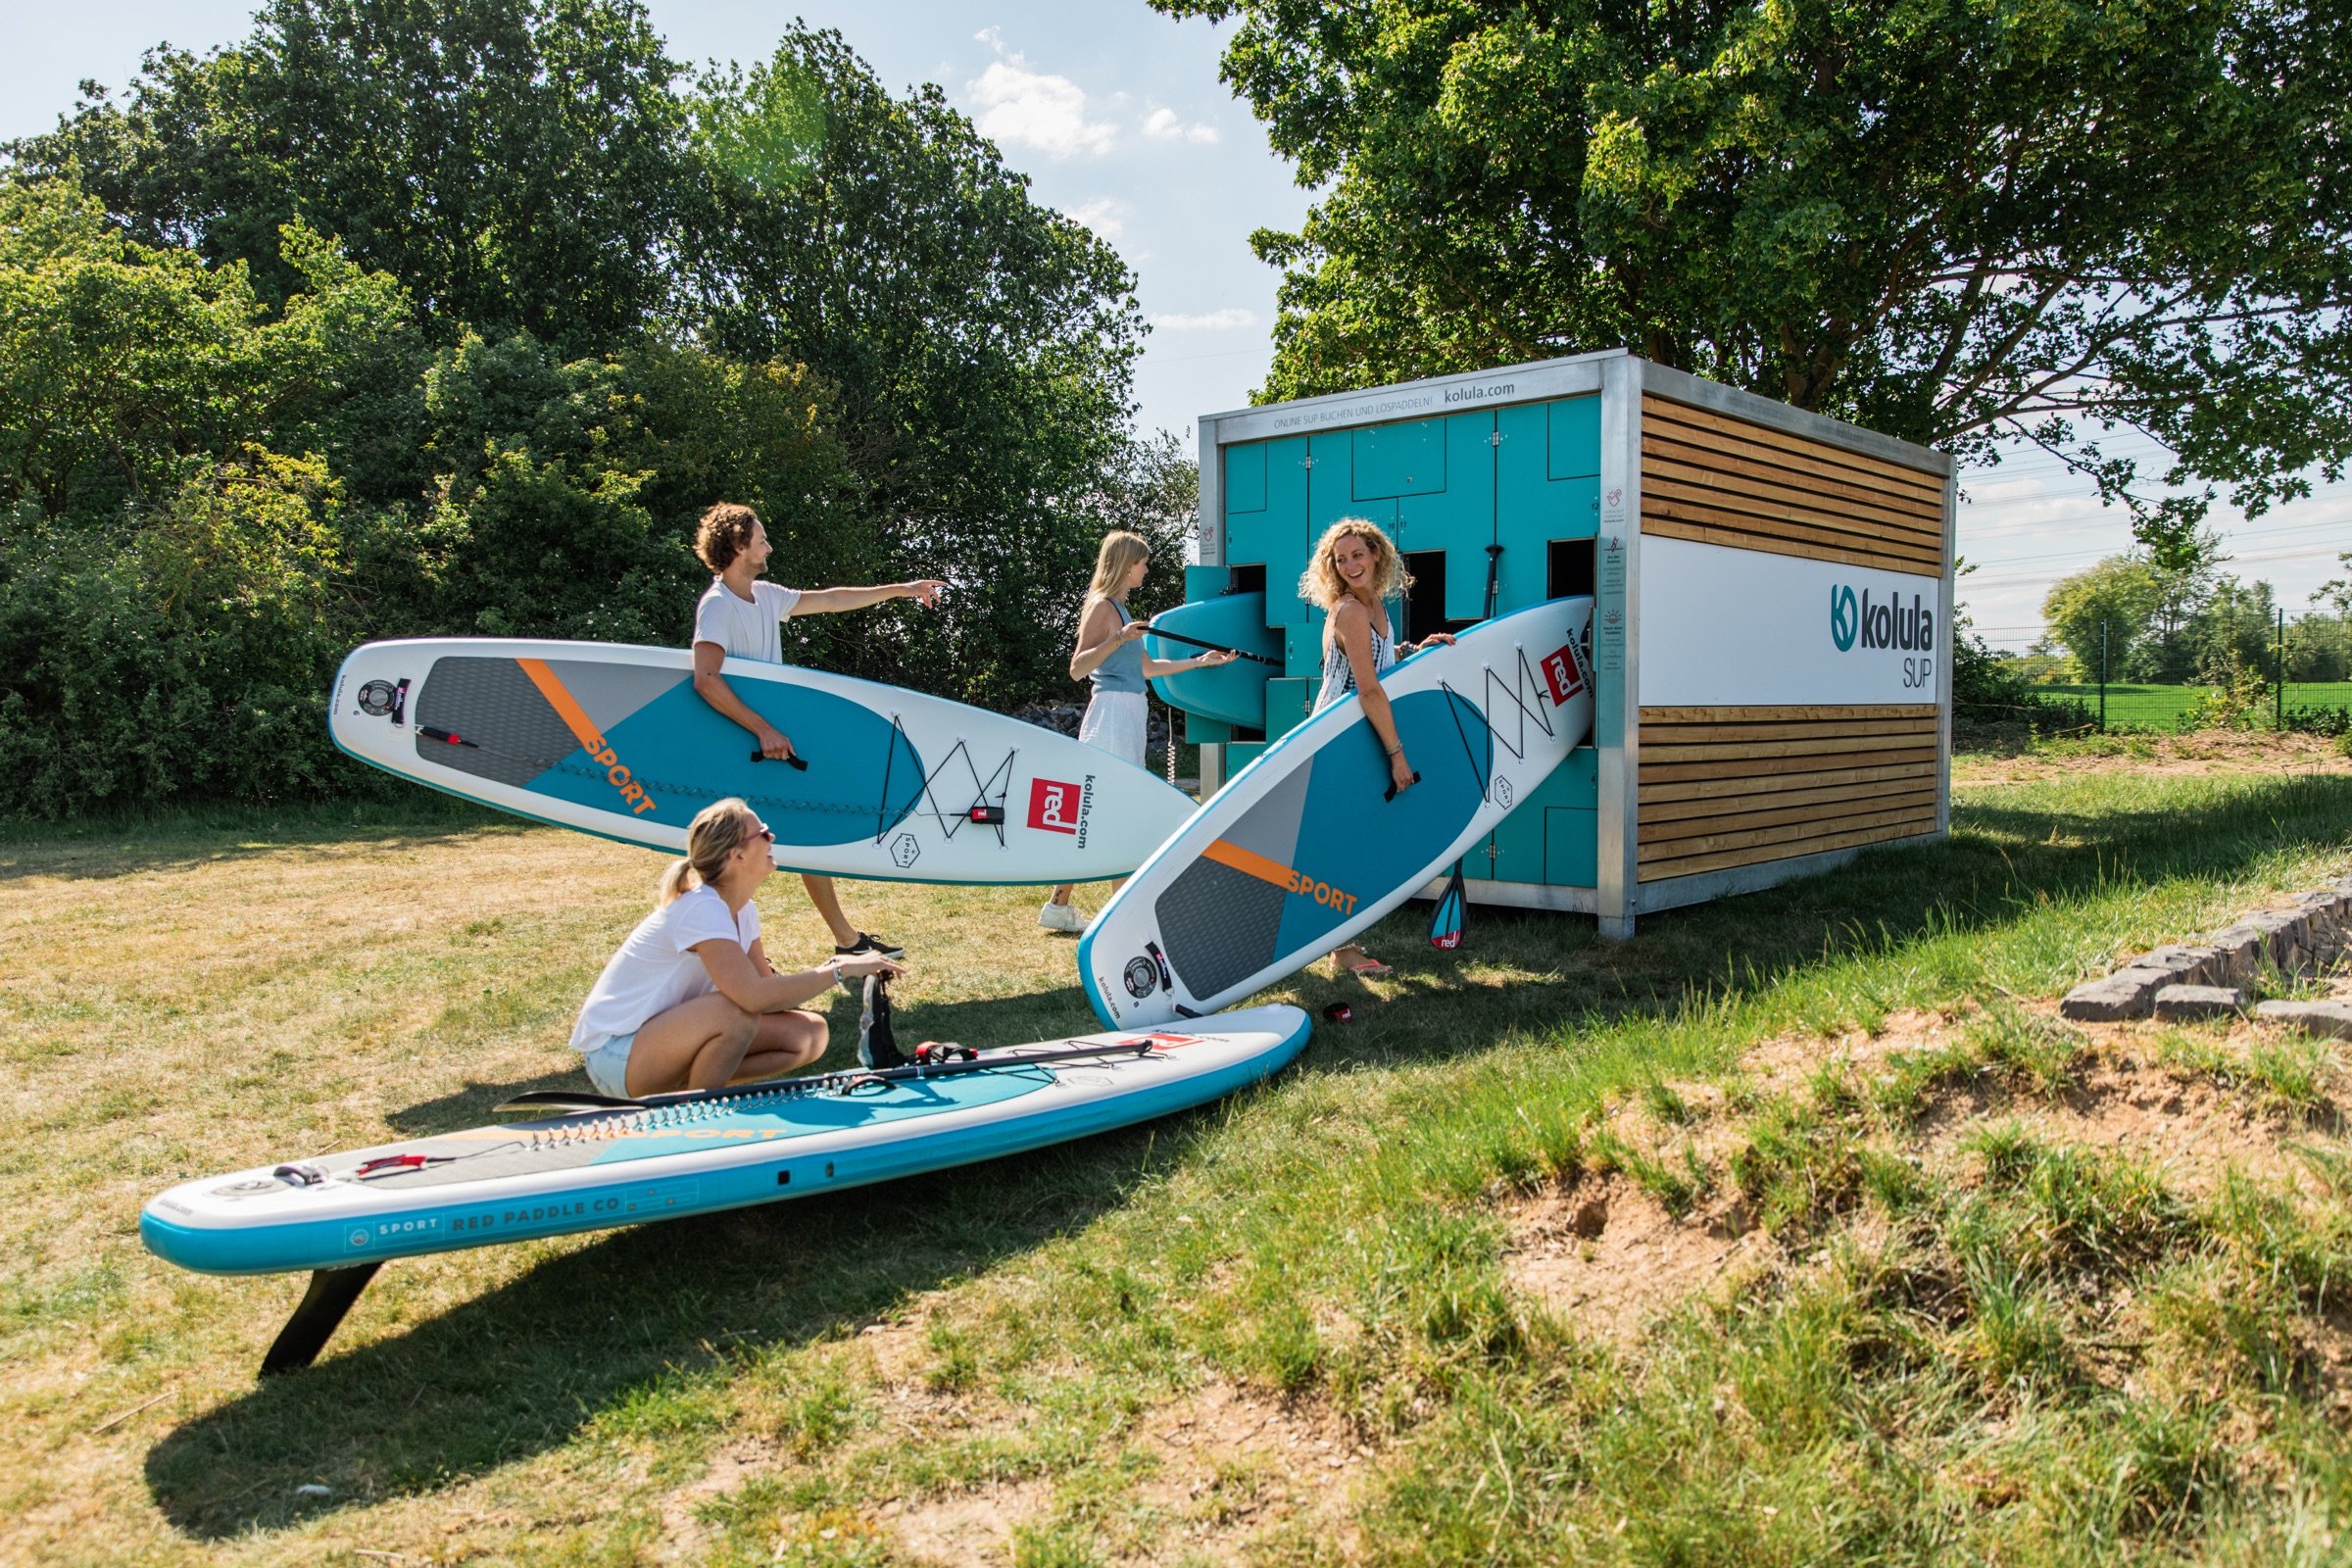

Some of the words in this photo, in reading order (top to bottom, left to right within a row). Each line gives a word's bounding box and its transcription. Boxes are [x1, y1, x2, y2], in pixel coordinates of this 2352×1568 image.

[1274, 416, 1301, 429] ONLINE
[1303, 414, 1319, 425] SUP
[1320, 409, 1353, 422] BUCHEN
[1355, 406, 1374, 416] UND
[1376, 396, 1434, 415] LOSPADDELN!
[1445, 383, 1515, 403] kolula.com
[1592, 502, 1599, 511] 12
[1861, 588, 1933, 652] kolula
[1550, 655, 1583, 697] red
[1566, 627, 1593, 699] kolula.com
[1903, 657, 1932, 688] SUP
[583, 736, 657, 815] SPORT
[1498, 779, 1510, 805] SPORT
[1042, 785, 1078, 829] red
[1077, 774, 1097, 850] kolula.com
[903, 837, 911, 864] SPORT
[1286, 869, 1358, 916] SPORT
[1441, 930, 1457, 948] red
[1099, 976, 1121, 1020] kolula.com
[379, 1218, 438, 1235] SPORT
[453, 1214, 494, 1231] RED
[504, 1201, 586, 1224] PADDLE
[594, 1197, 619, 1212] CO
